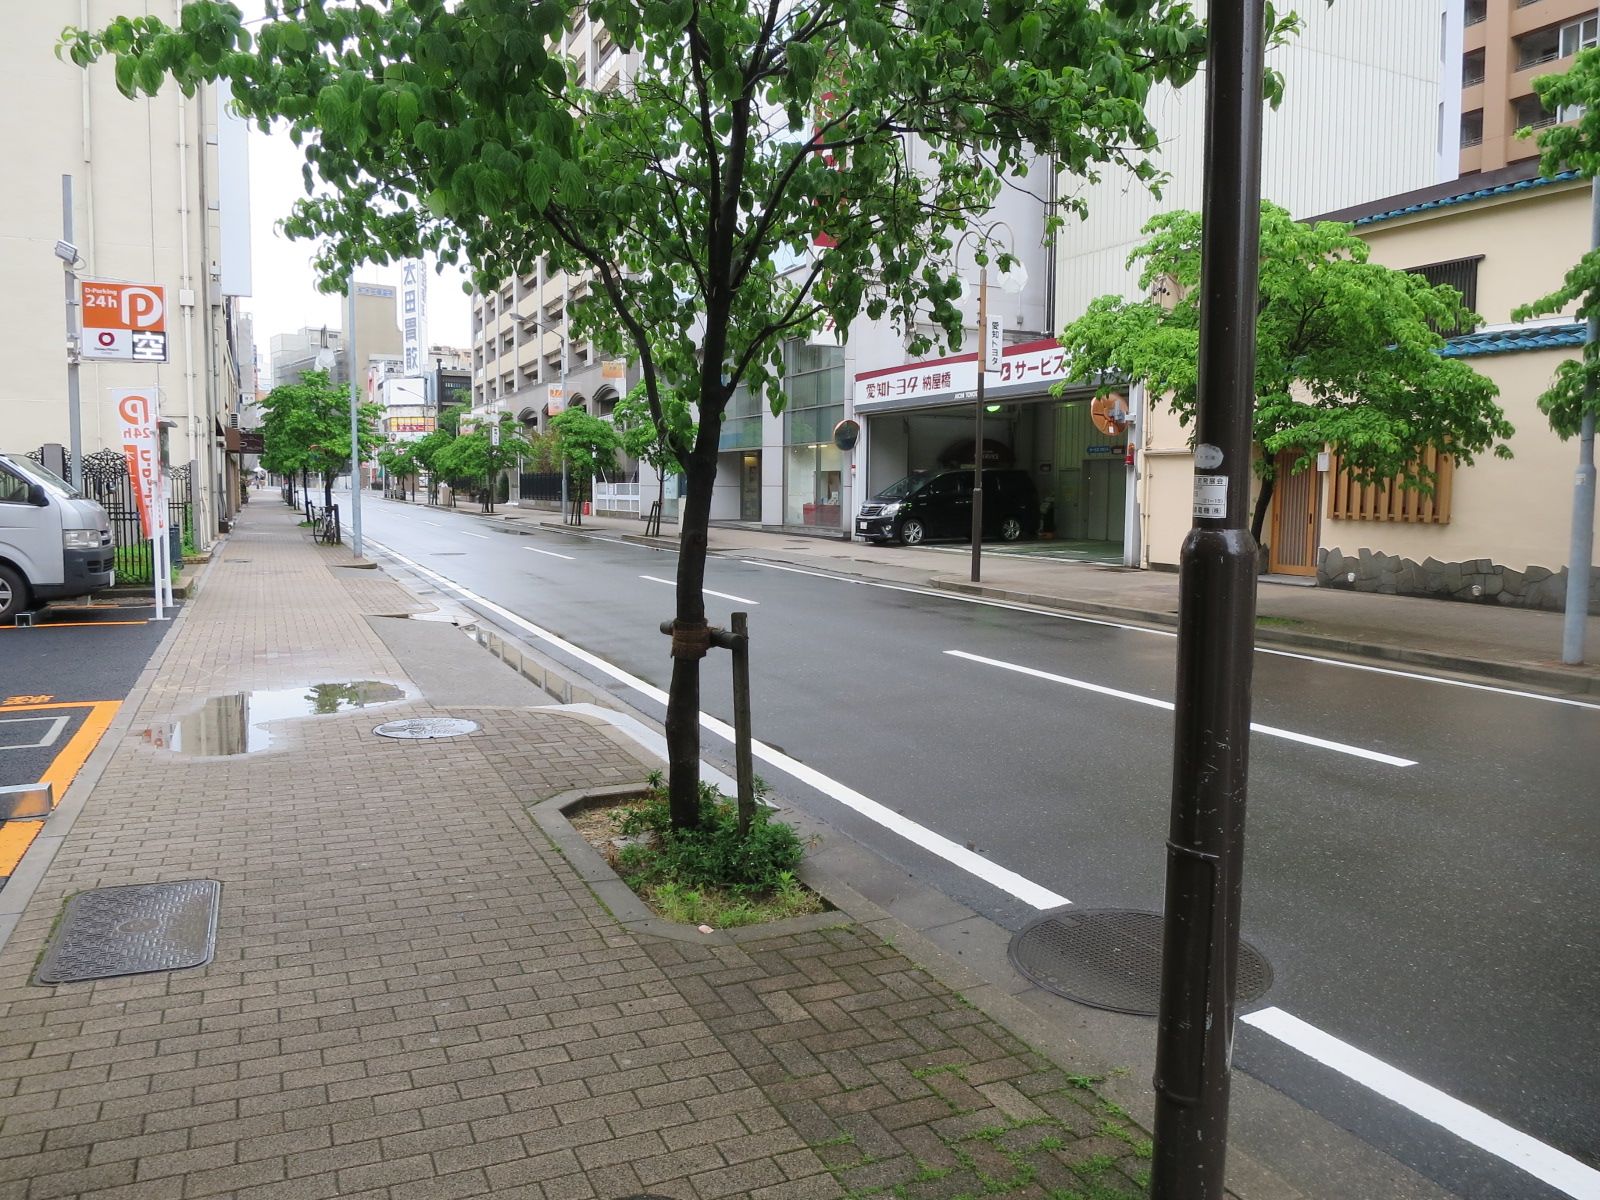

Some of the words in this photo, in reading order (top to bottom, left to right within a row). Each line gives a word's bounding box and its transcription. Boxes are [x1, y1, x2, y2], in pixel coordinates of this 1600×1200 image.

[85, 287, 117, 296] D-Parking
[86, 295, 118, 308] 24h
[403, 261, 418, 370] 太田胃散
[133, 331, 165, 360] 空
[1015, 354, 1066, 380] サービス
[865, 376, 918, 399] 愛知トヨタ
[922, 371, 951, 391] 納屋橋
